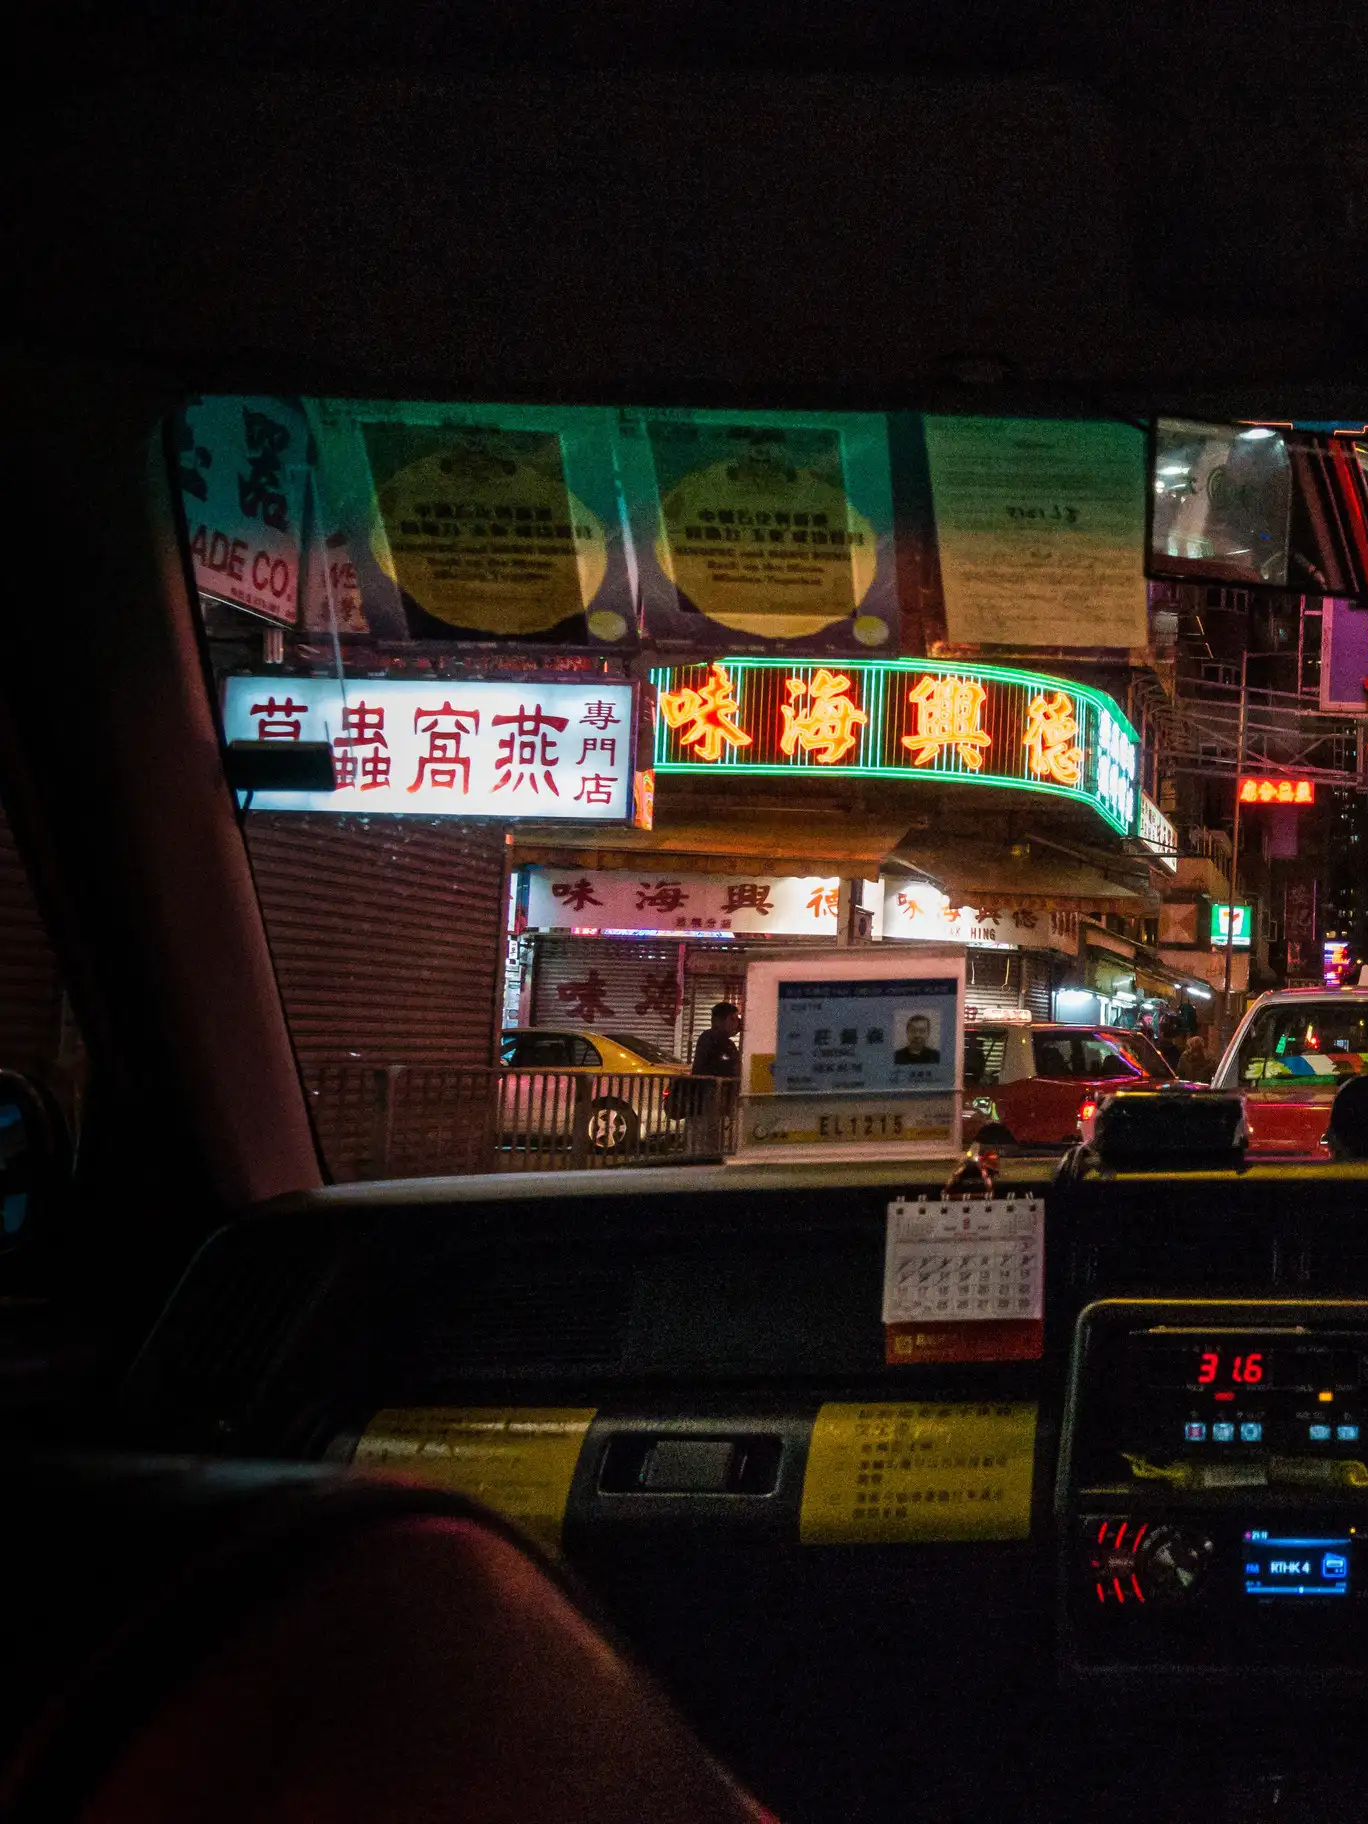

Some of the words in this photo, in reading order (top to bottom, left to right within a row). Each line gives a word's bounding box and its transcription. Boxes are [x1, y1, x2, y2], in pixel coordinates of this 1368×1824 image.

[252, 551, 292, 602] CO.
[970, 928, 996, 941] HING
[818, 1115, 905, 1136] EL1215
[1270, 1560, 1300, 1574] RTHK
[1301, 1561, 1310, 1574] 4
